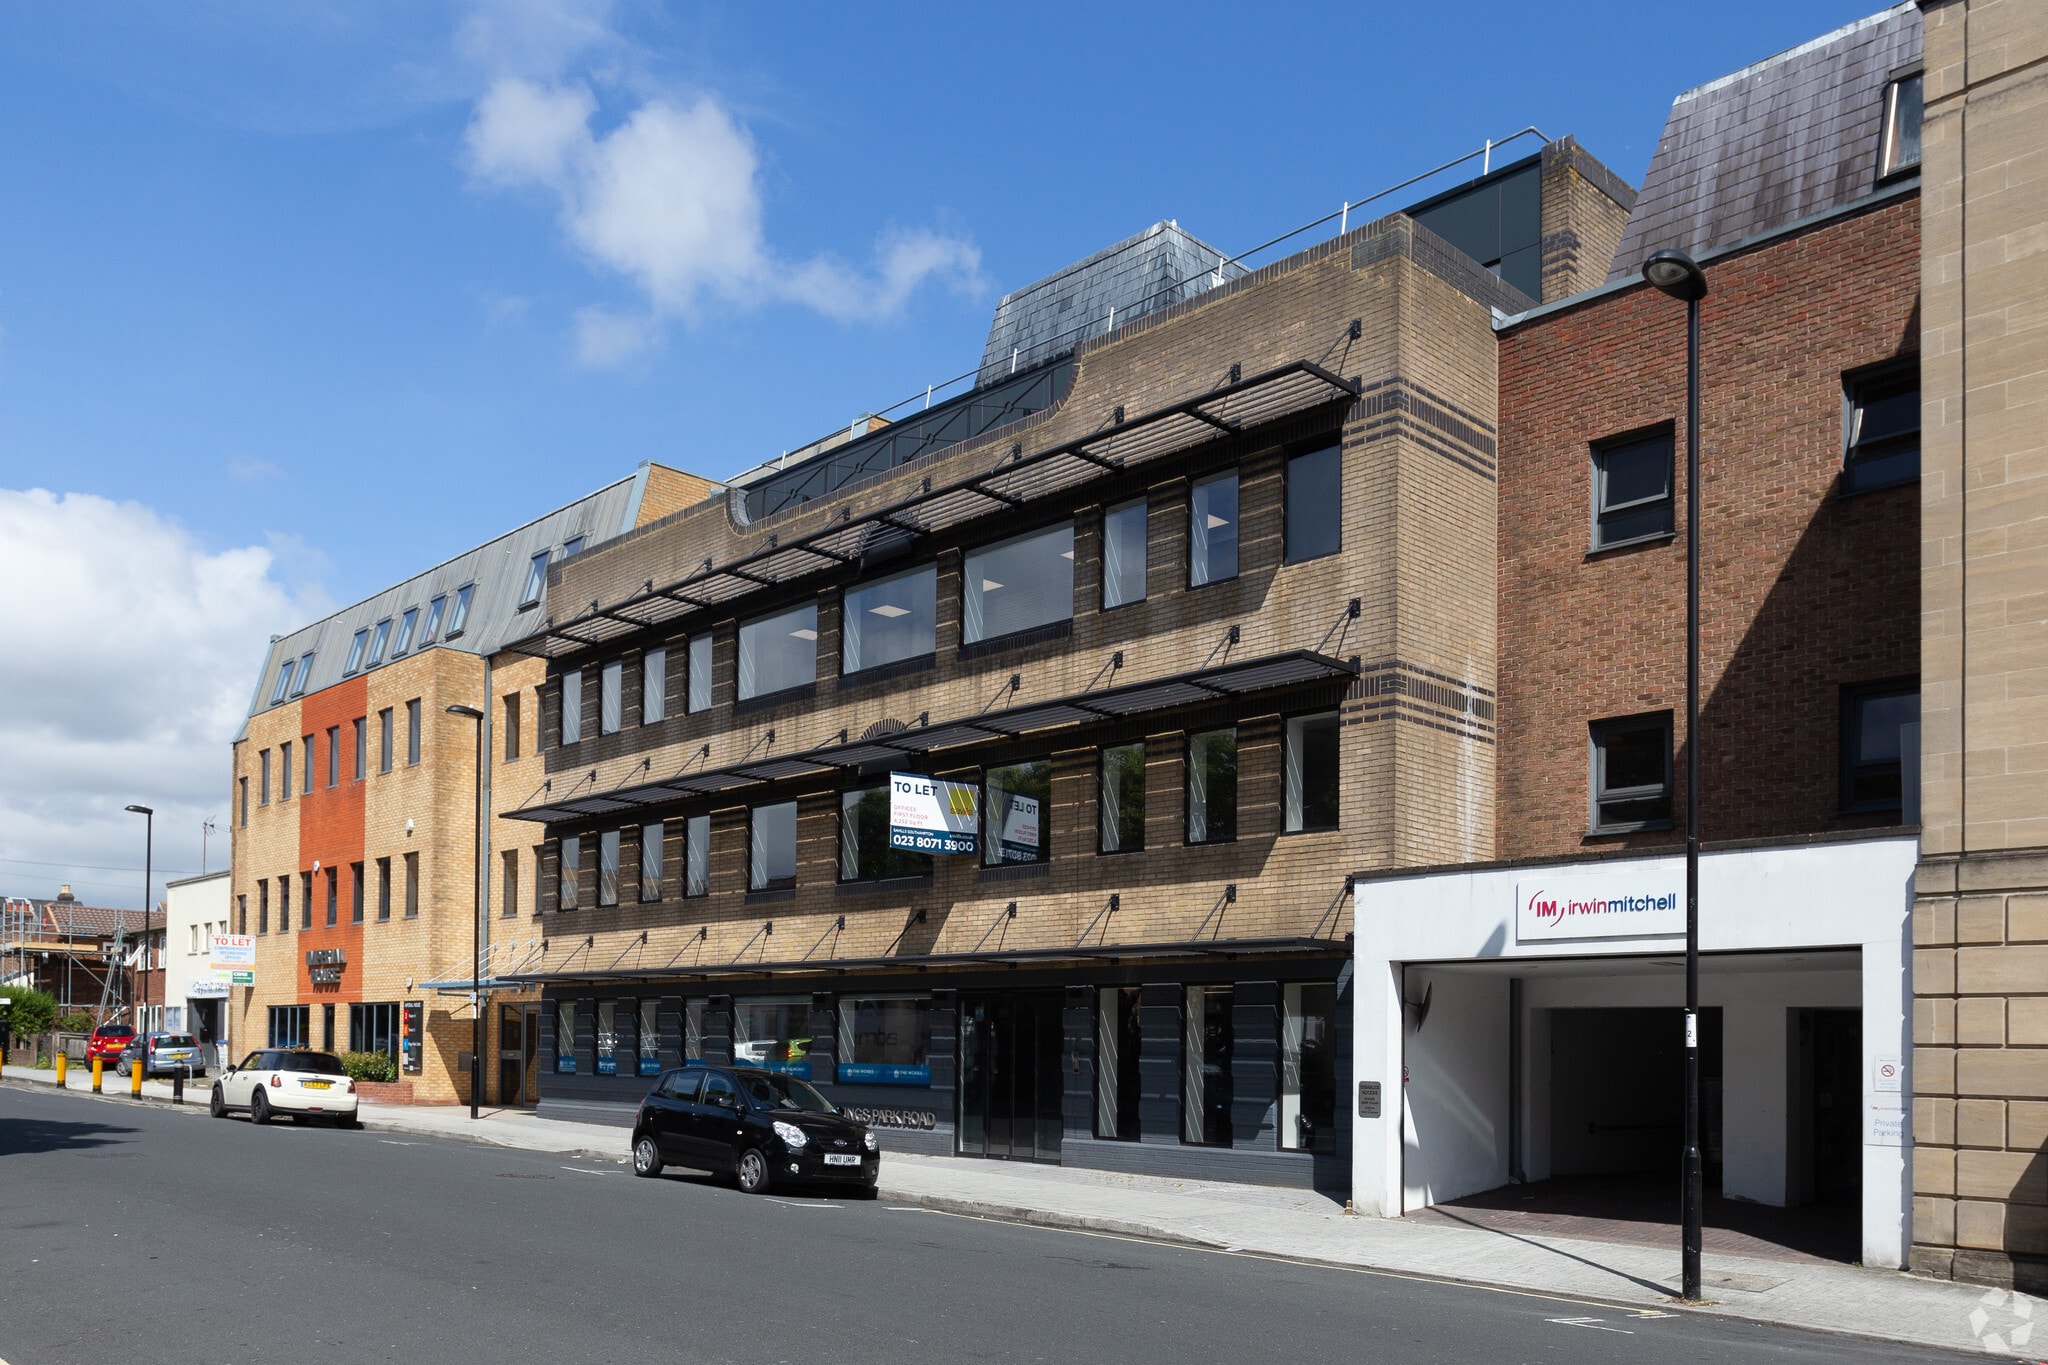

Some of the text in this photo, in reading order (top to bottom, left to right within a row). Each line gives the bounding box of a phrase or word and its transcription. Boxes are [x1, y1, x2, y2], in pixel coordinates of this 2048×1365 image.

[894, 781, 938, 796] TO LET
[893, 804, 917, 812] OFFICES
[950, 807, 973, 816] savills
[893, 834, 974, 851] 023 8071 3900
[1568, 893, 1676, 916] irwinmitchell
[214, 937, 251, 946] TO LET
[843, 1107, 936, 1126] INGS PARK ROAD
[1874, 1118, 1904, 1128] Private
[1873, 1128, 1904, 1138] Parking
[843, 1156, 856, 1164] UMR
